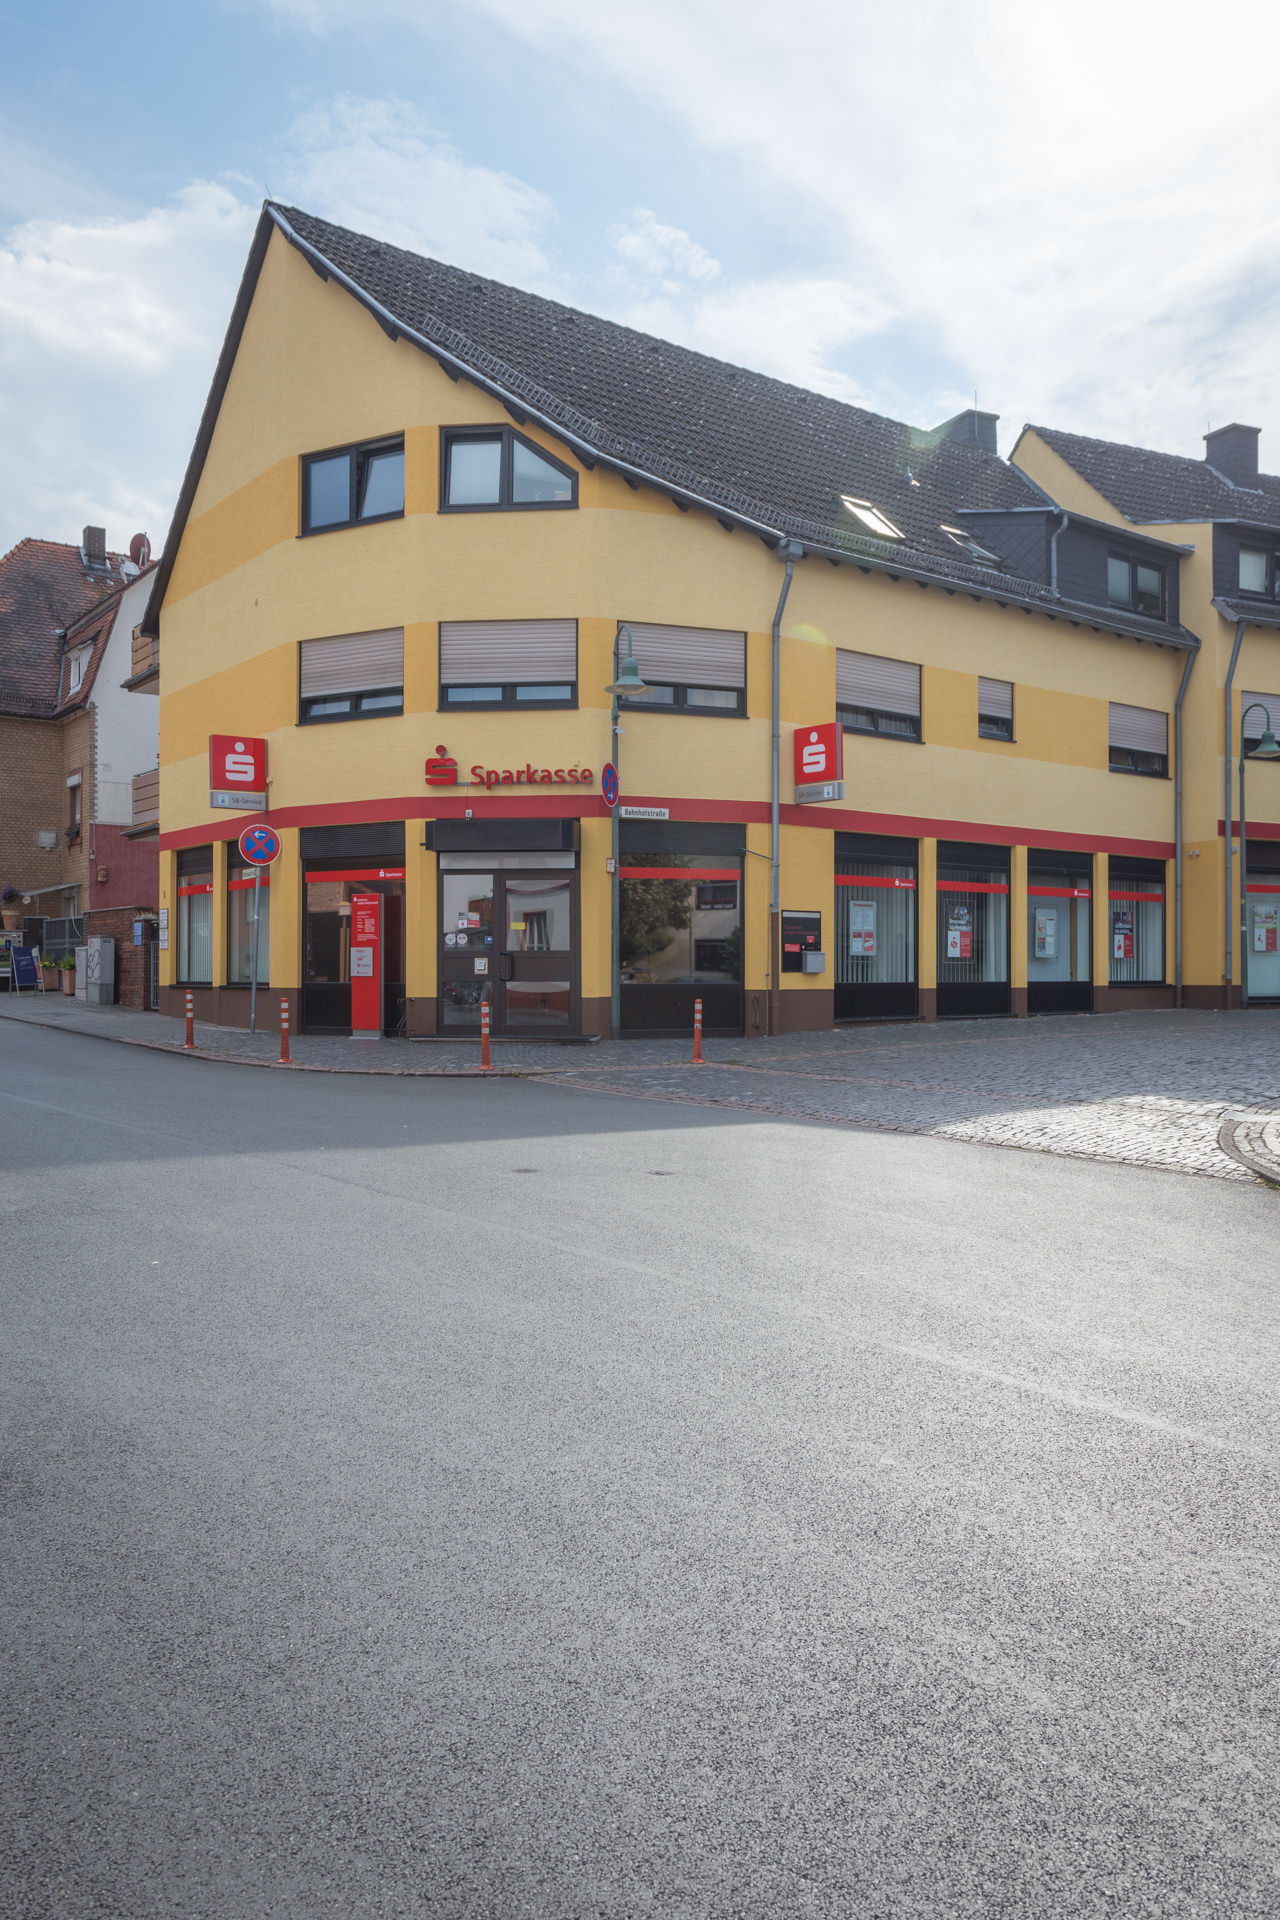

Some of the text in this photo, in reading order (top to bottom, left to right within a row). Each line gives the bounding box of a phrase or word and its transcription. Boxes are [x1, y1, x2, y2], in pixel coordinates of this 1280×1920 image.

[470, 763, 593, 790] Sparkasse
[231, 797, 262, 806] SB-Service
[624, 808, 666, 817] Bahnhofstraße
